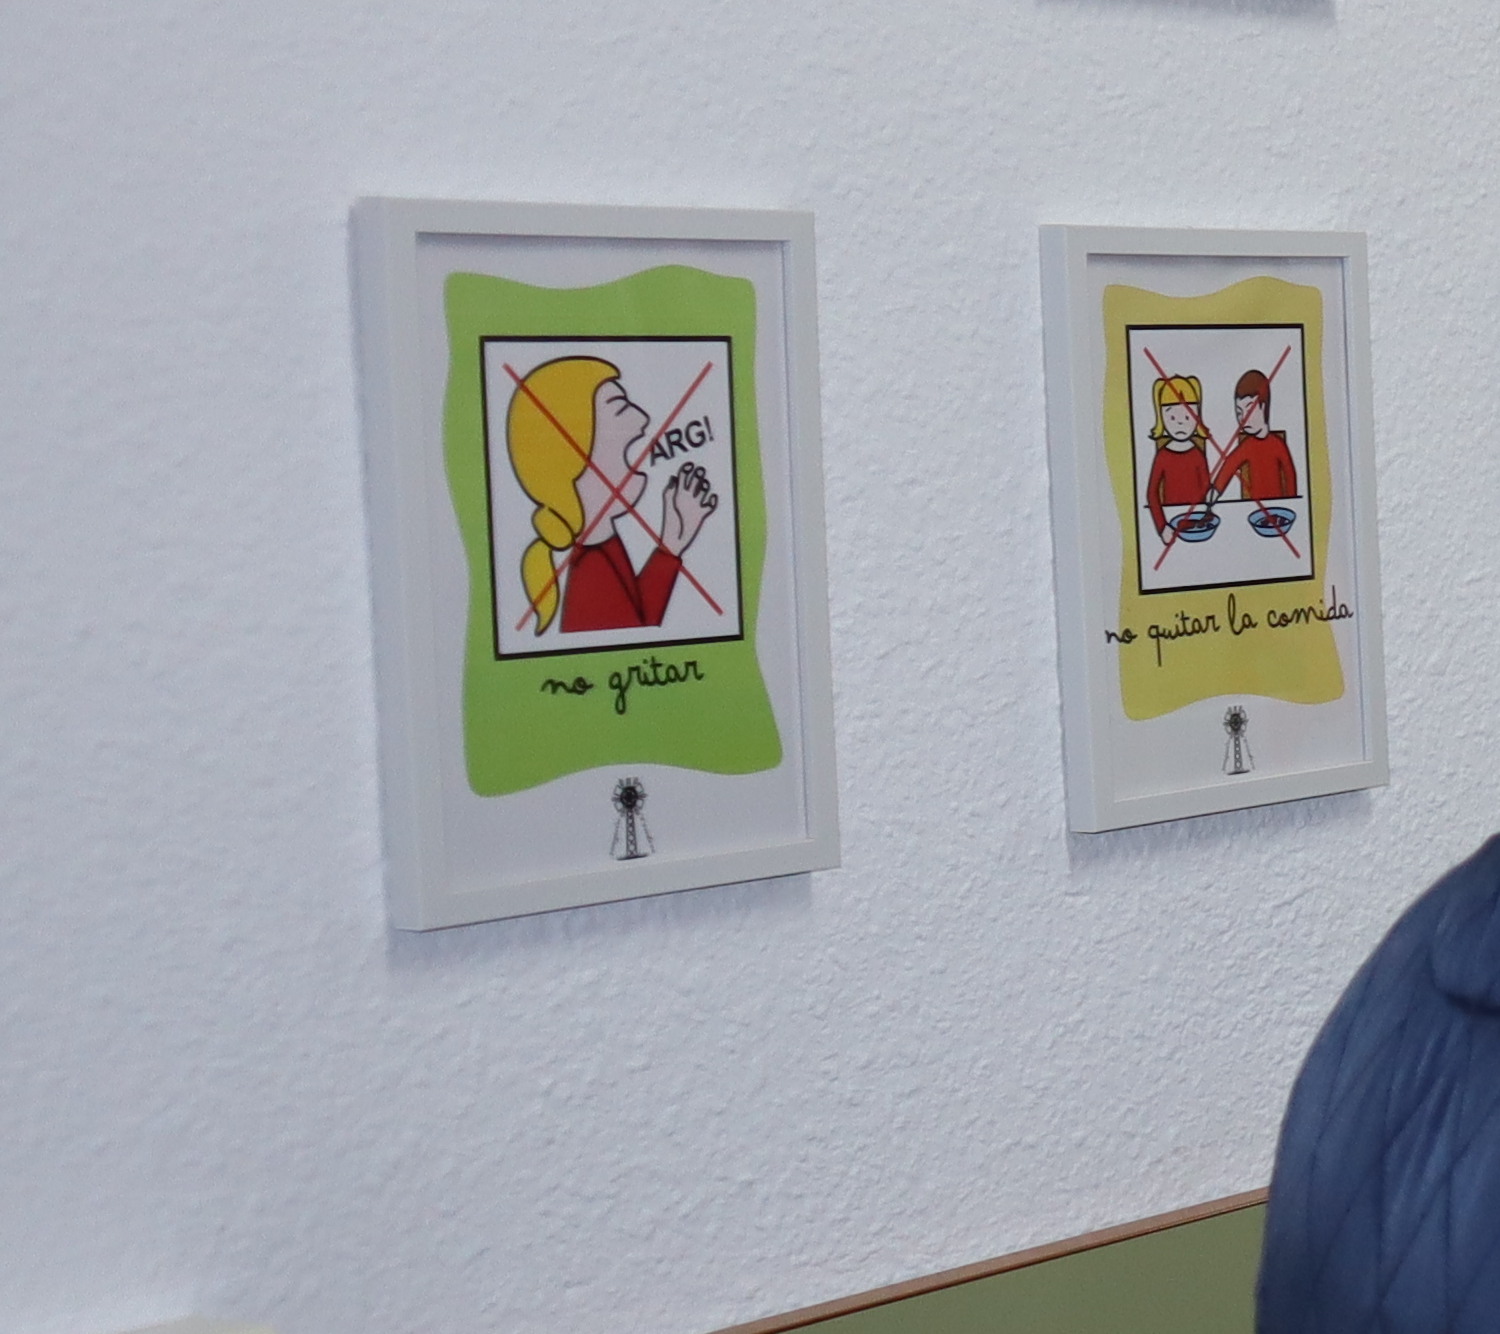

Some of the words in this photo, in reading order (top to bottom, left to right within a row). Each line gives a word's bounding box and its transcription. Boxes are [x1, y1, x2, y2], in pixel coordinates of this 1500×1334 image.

[650, 415, 715, 467] ARG!
[1104, 627, 1138, 645] no
[1147, 609, 1221, 667] quitar
[1227, 593, 1258, 636] la
[1267, 585, 1354, 628] comida
[540, 676, 594, 696] no
[608, 656, 704, 716] gritar
